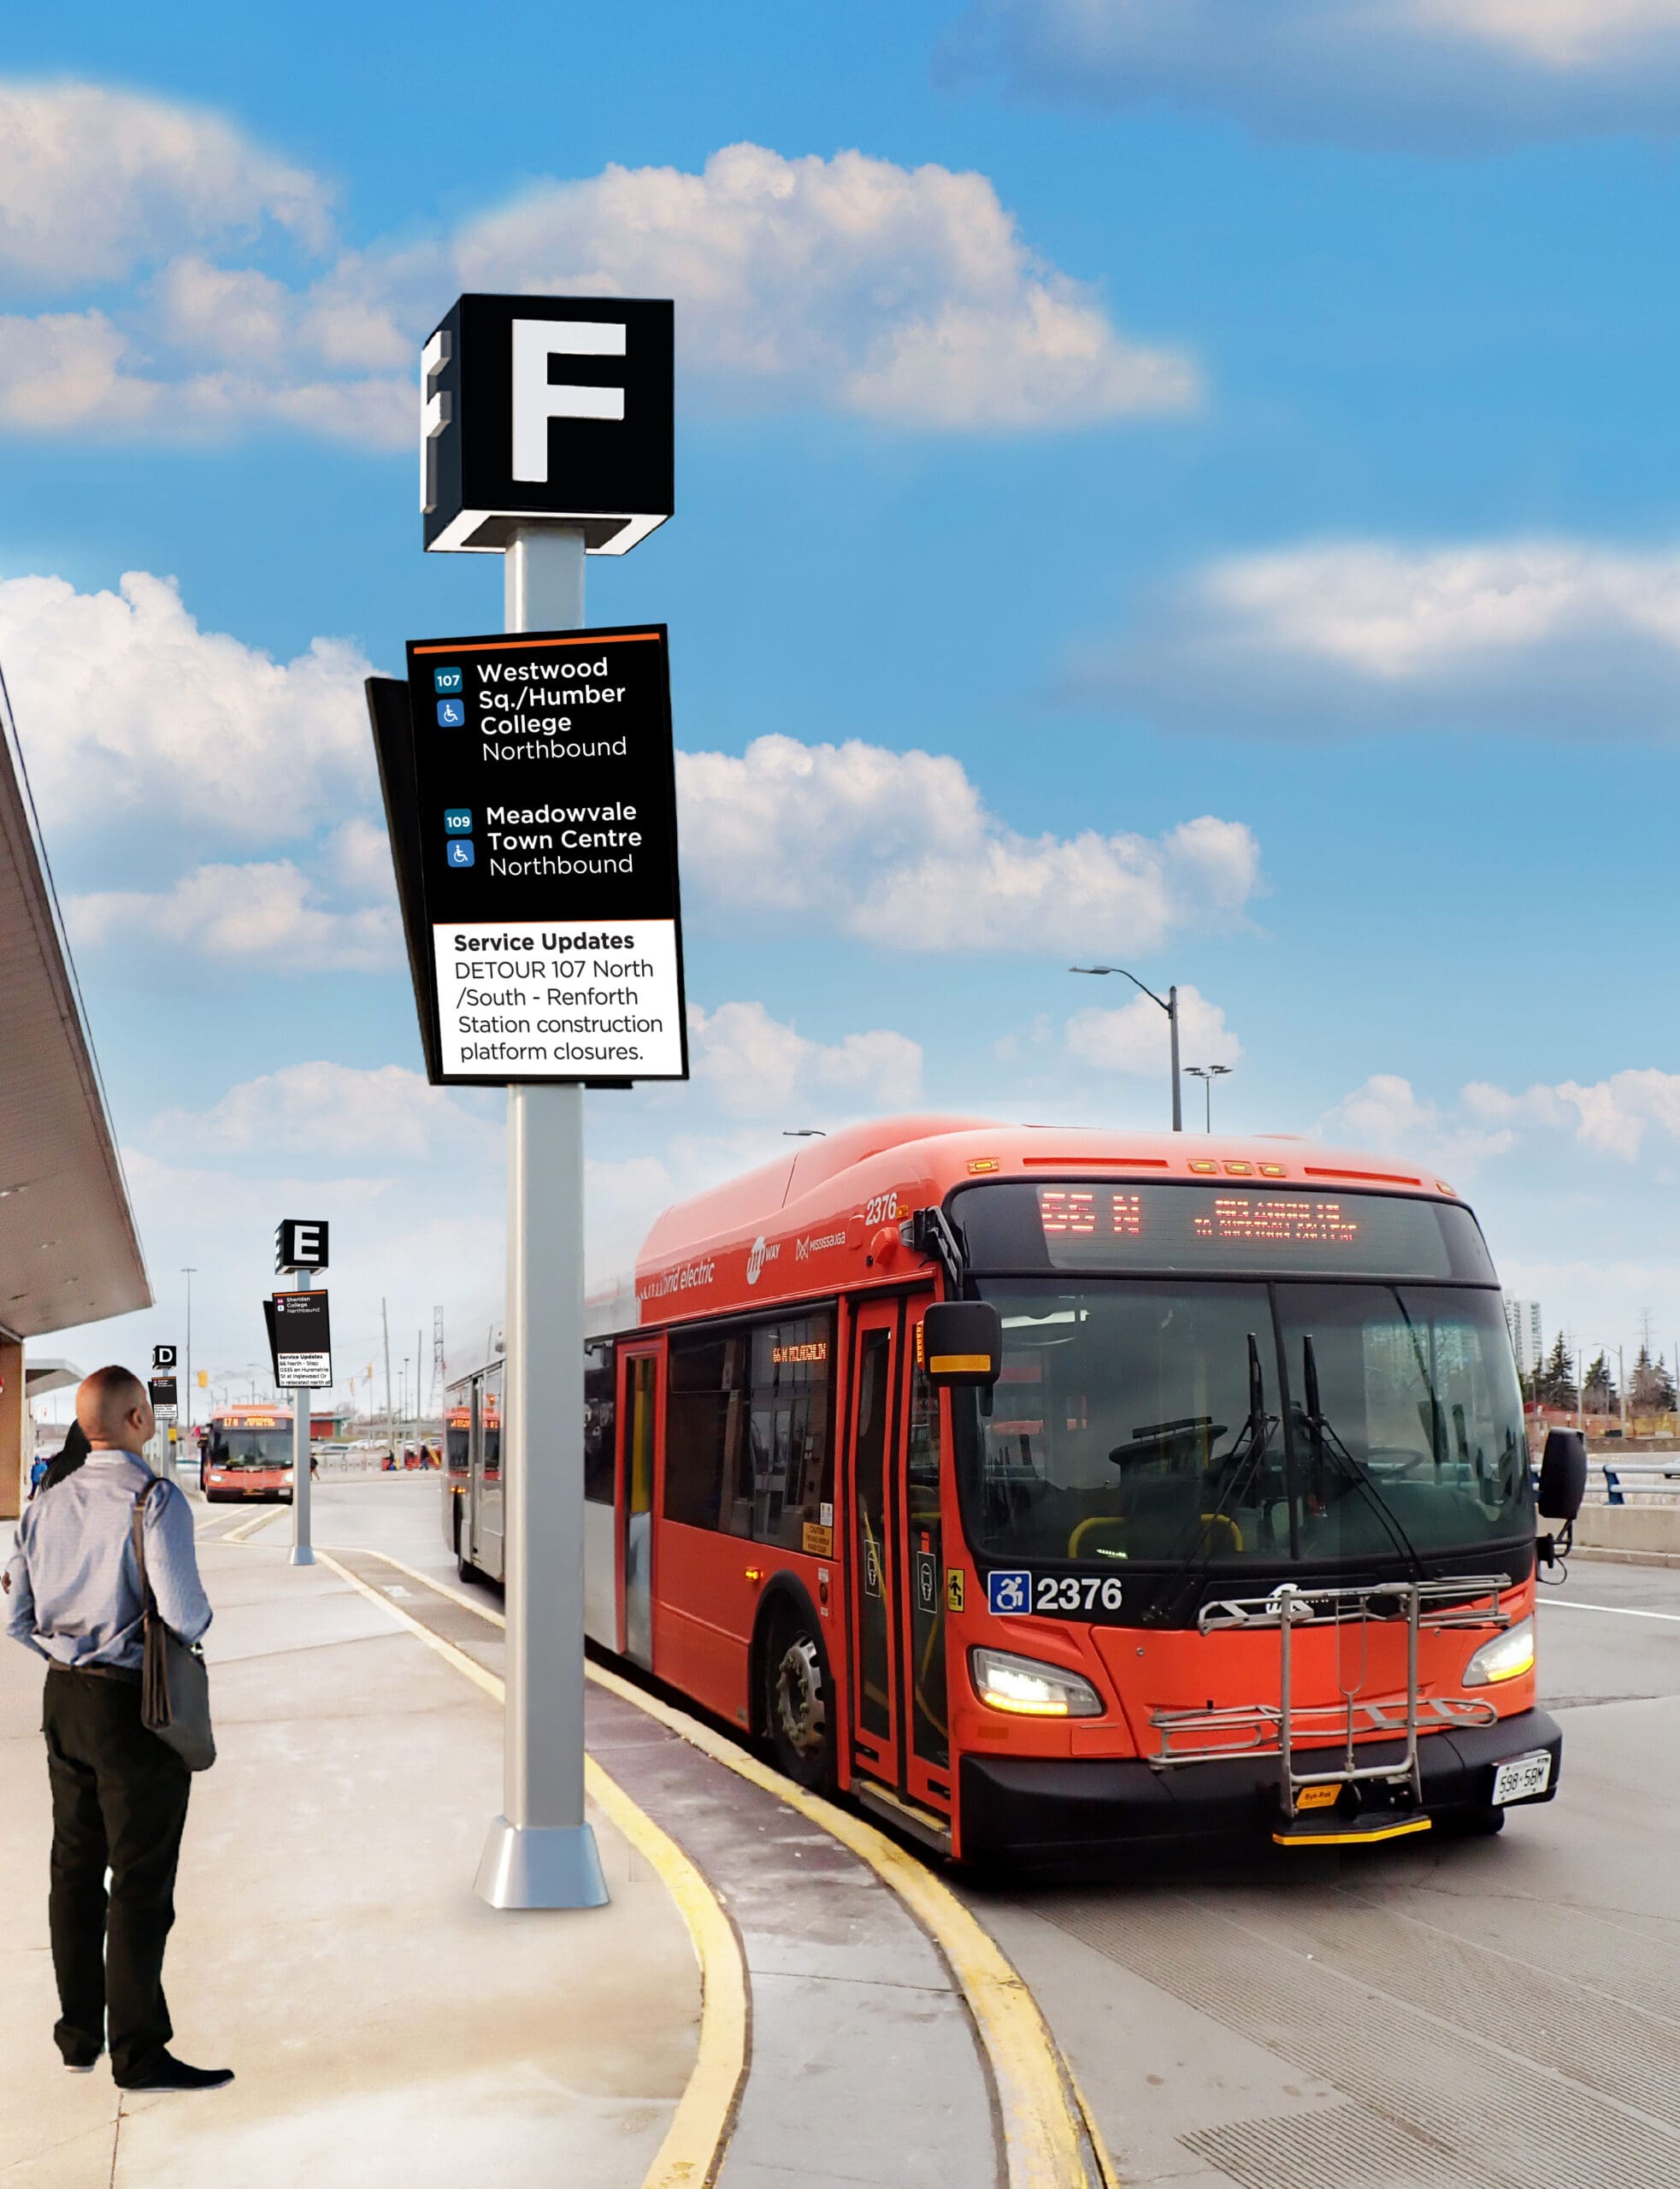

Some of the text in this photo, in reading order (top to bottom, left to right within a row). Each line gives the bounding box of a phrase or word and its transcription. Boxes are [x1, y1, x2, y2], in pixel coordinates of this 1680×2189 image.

[511, 319, 627, 482] F
[476, 656, 608, 683] Westwood
[437, 675, 460, 687] 107
[479, 684, 626, 712] Sq./Humber
[480, 714, 572, 736] College
[482, 735, 627, 761] Northbound
[446, 816, 470, 828] 109
[486, 801, 637, 825] Meadowvale
[486, 829, 642, 851] Town Centre
[490, 853, 633, 876] Northbound
[454, 931, 634, 953] Service Updates
[455, 959, 653, 979] DETOUR 107 North
[456, 987, 526, 1009] /South
[547, 987, 638, 1006] Renforth
[458, 1016, 663, 1033] Station construction
[461, 1041, 643, 1063] platform closures.
[865, 1192, 898, 1226] 2376
[293, 1224, 321, 1261] E
[680, 1257, 716, 1289] electric
[159, 1348, 173, 1363] D
[1036, 1578, 1123, 1610] 2376
